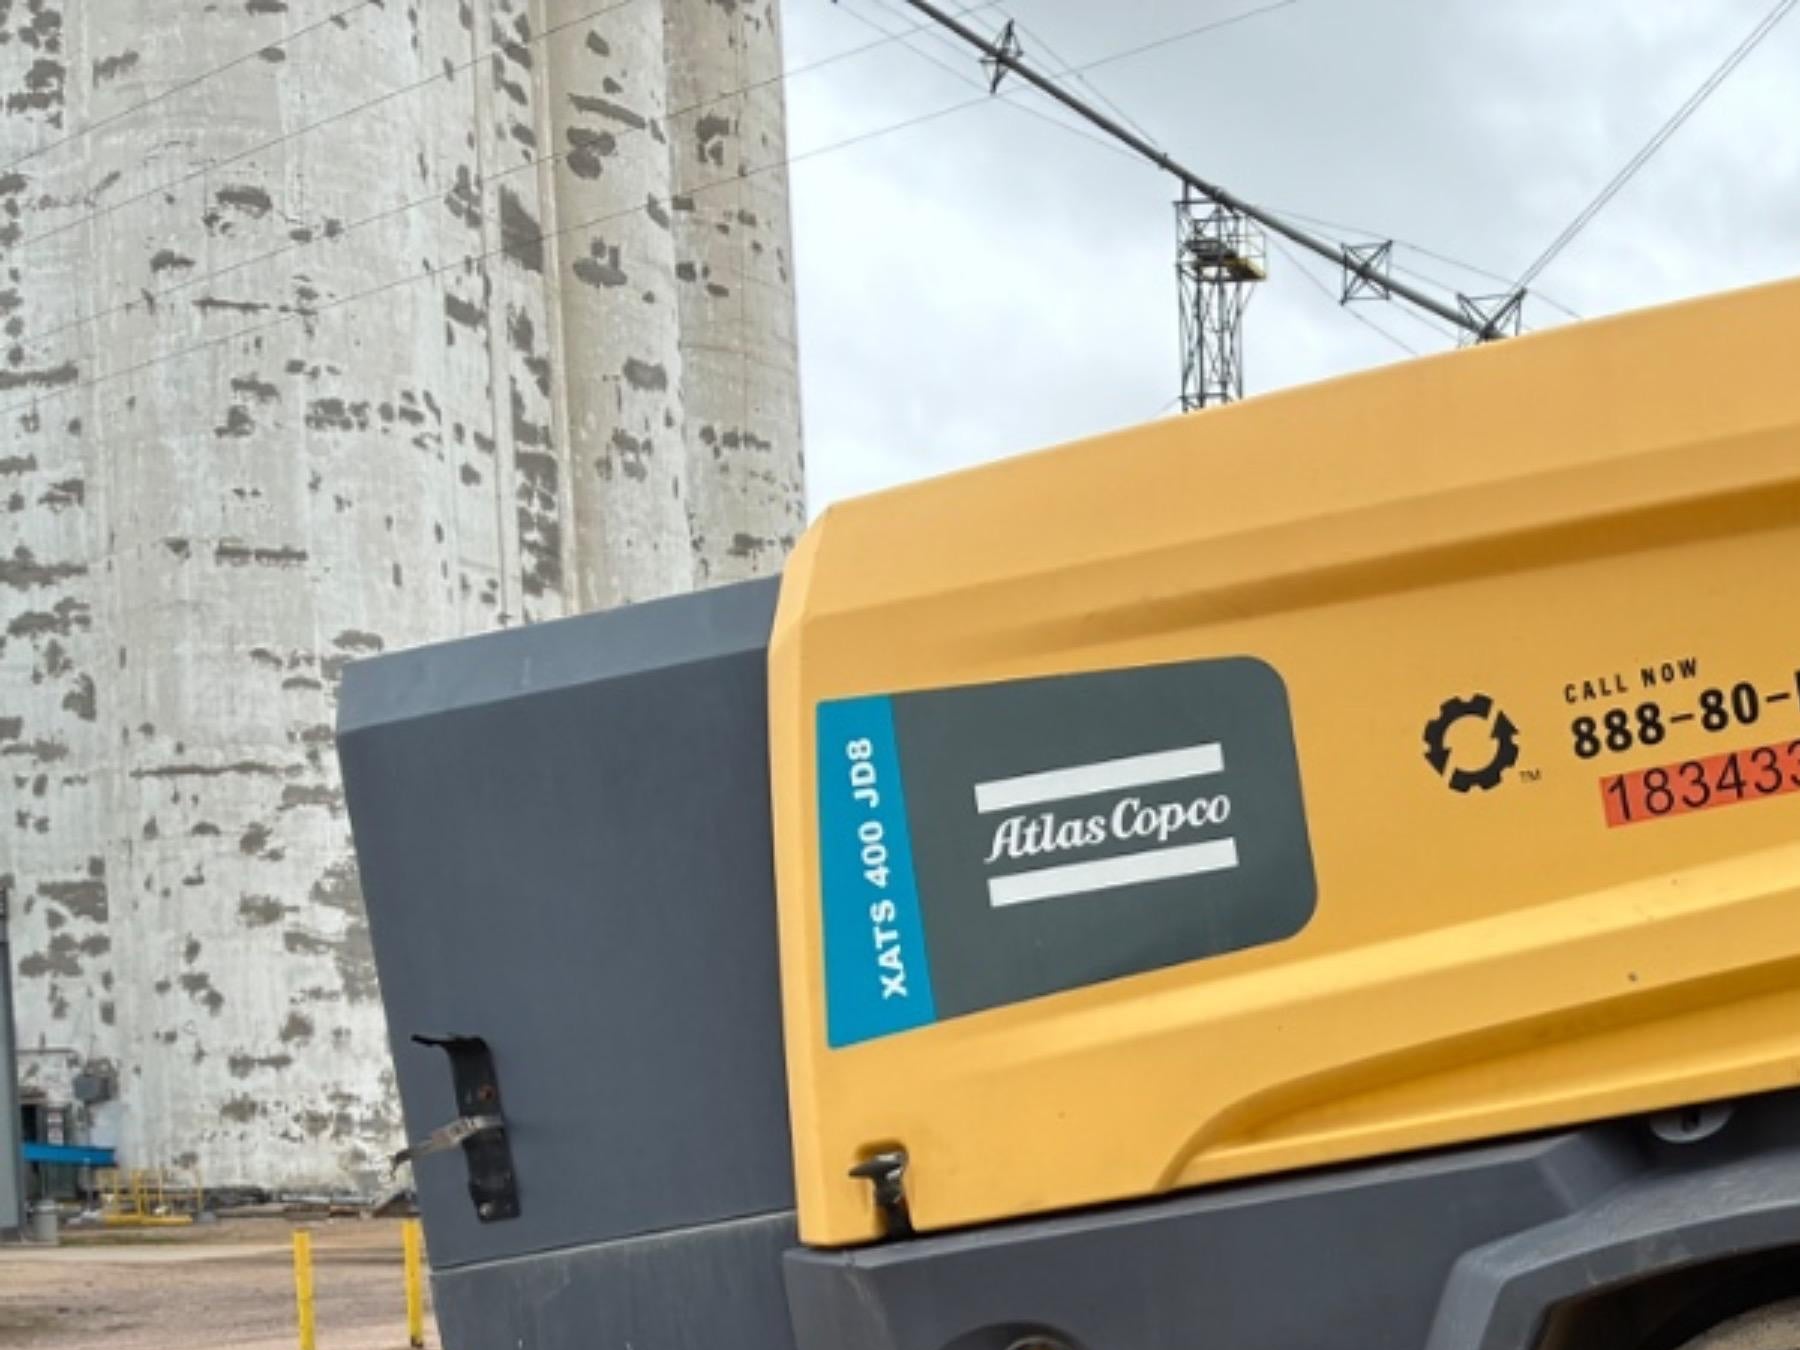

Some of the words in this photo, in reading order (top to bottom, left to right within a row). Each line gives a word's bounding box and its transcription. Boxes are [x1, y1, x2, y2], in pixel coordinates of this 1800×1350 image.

[1564, 673, 1628, 703] CALL
[1641, 658, 1697, 687] NOW
[846, 738, 878, 808] JD8
[858, 821, 890, 888] 400
[984, 810, 1107, 863] Atlas
[1111, 794, 1231, 842] Copco
[869, 899, 908, 1000] XATS
